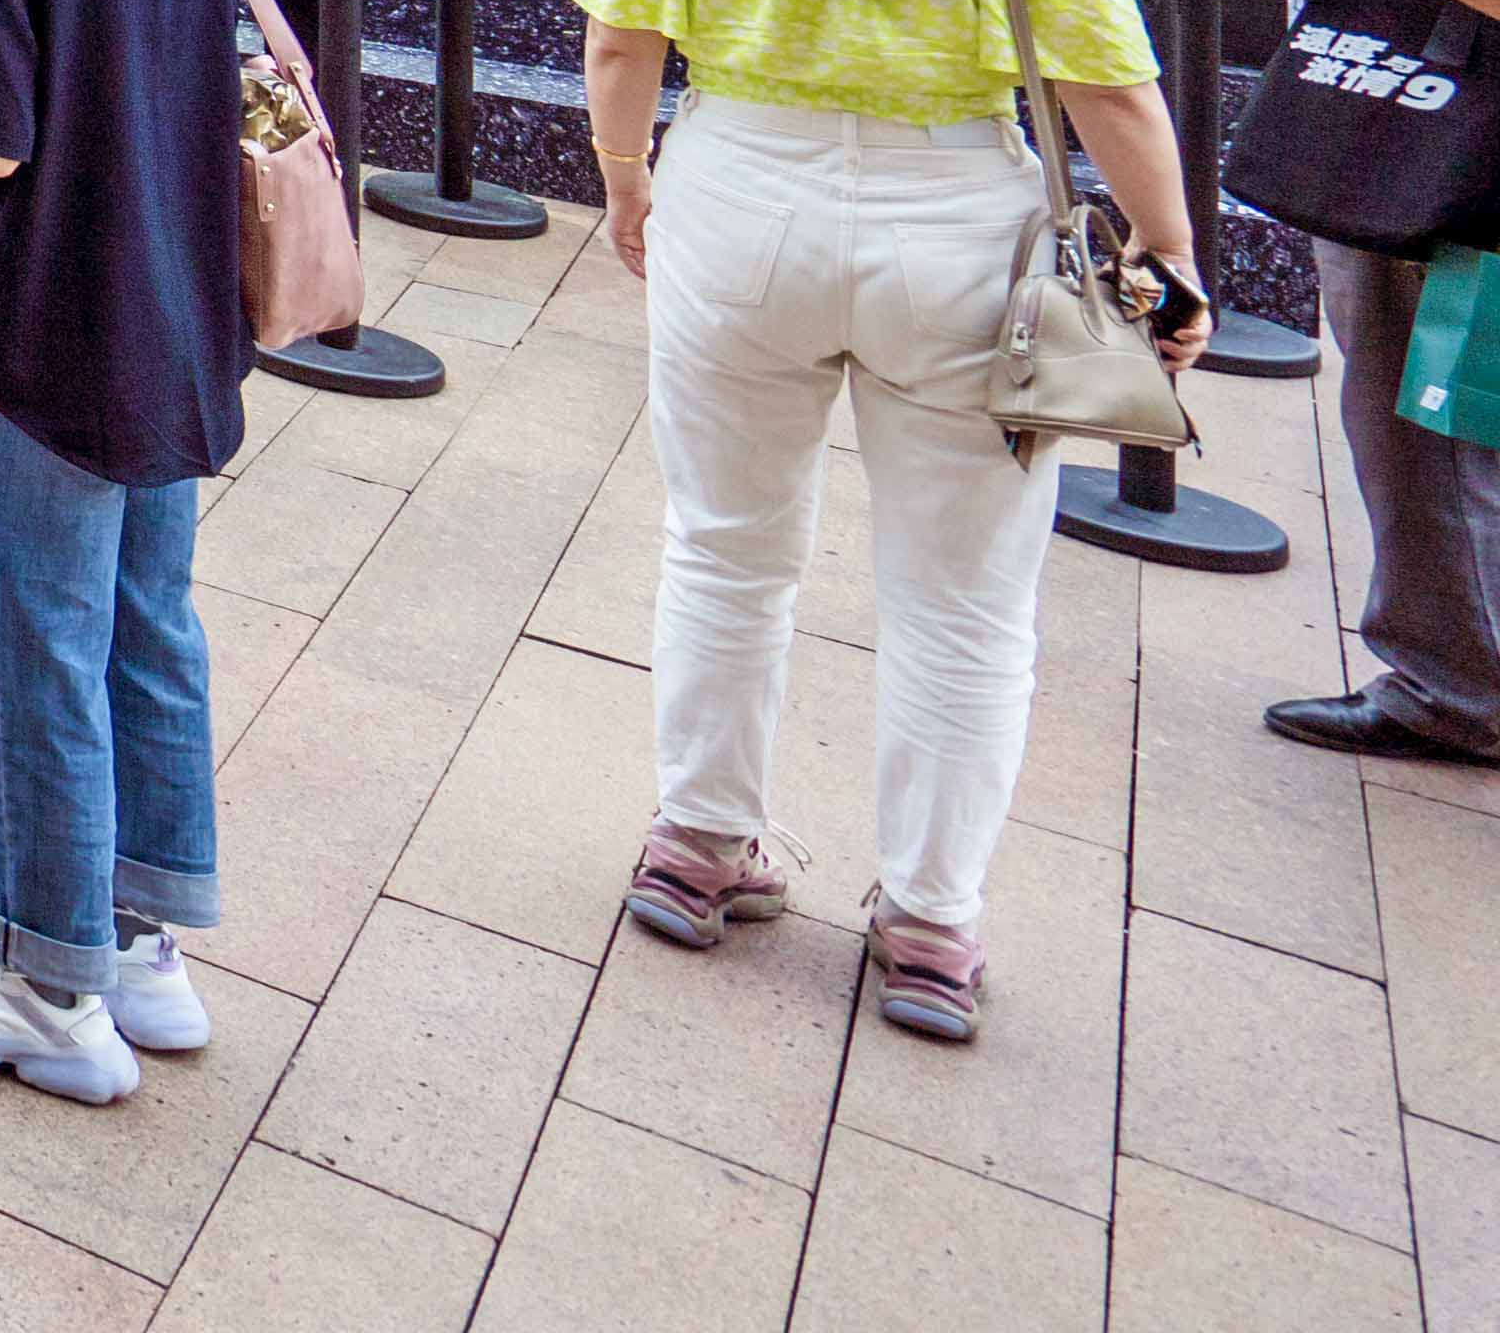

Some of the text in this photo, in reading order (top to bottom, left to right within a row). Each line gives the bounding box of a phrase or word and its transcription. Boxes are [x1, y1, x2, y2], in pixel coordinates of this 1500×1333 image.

[1289, 24, 1425, 74] 速度与
[1298, 55, 1457, 111] 激情9
